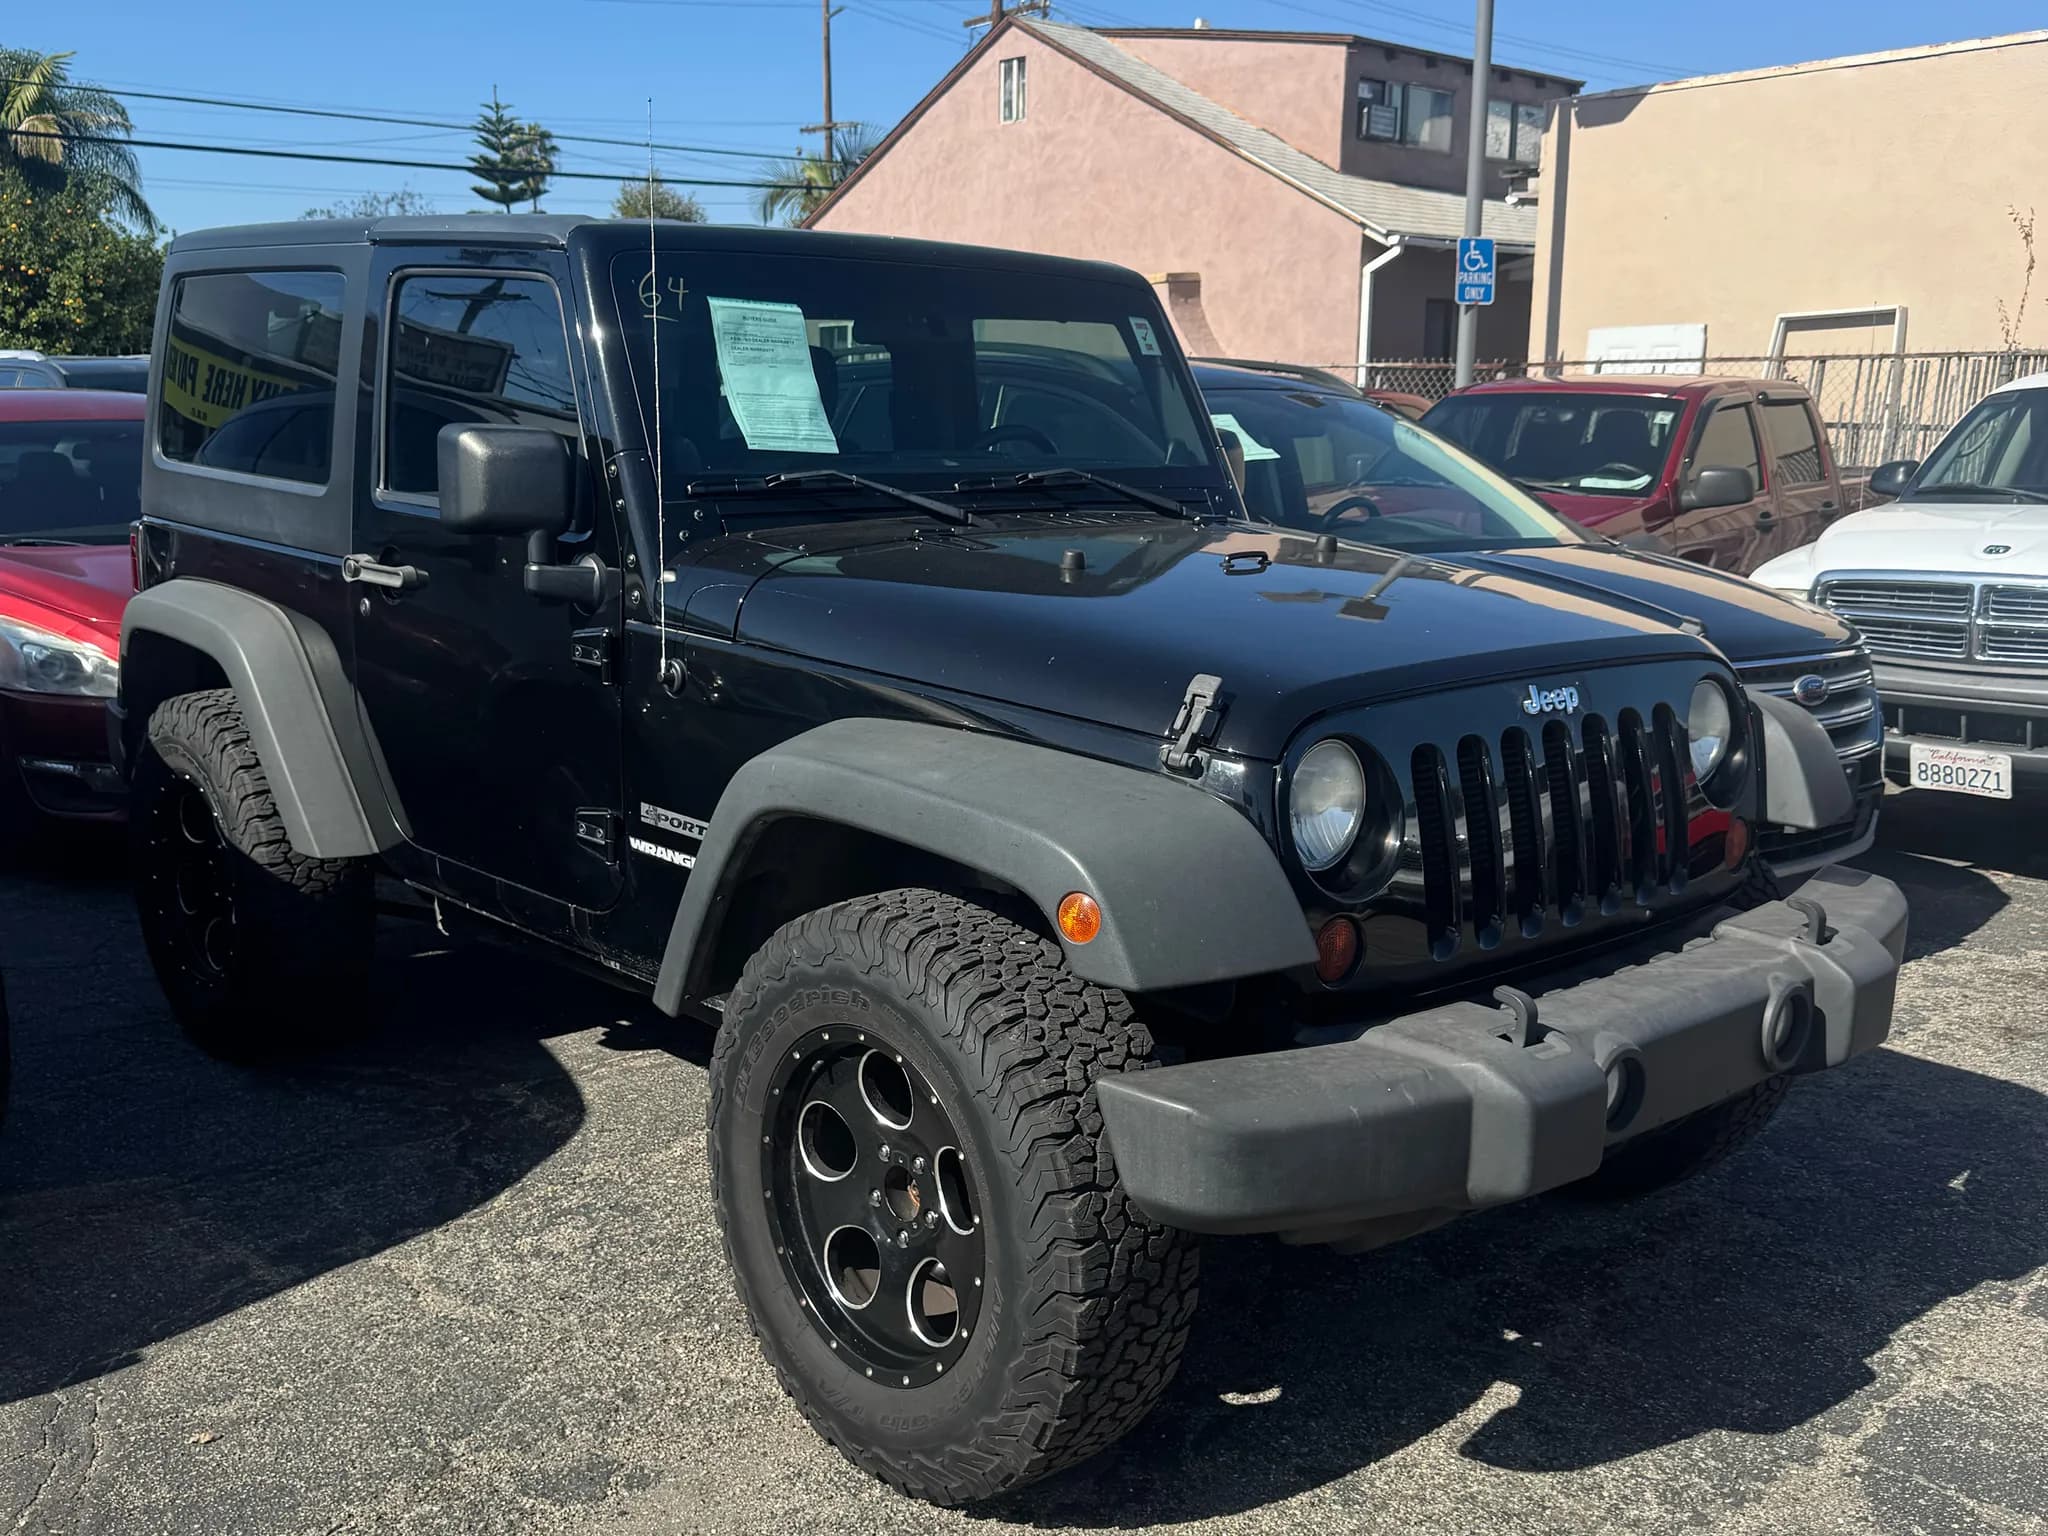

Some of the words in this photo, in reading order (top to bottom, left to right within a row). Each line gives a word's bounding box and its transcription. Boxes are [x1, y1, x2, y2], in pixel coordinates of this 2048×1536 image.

[638, 270, 689, 312] 64
[1458, 271, 1492, 285] PARKING
[1464, 286, 1486, 300] ONLY
[1523, 684, 1579, 715] Jeep
[644, 805, 708, 836] SPORT
